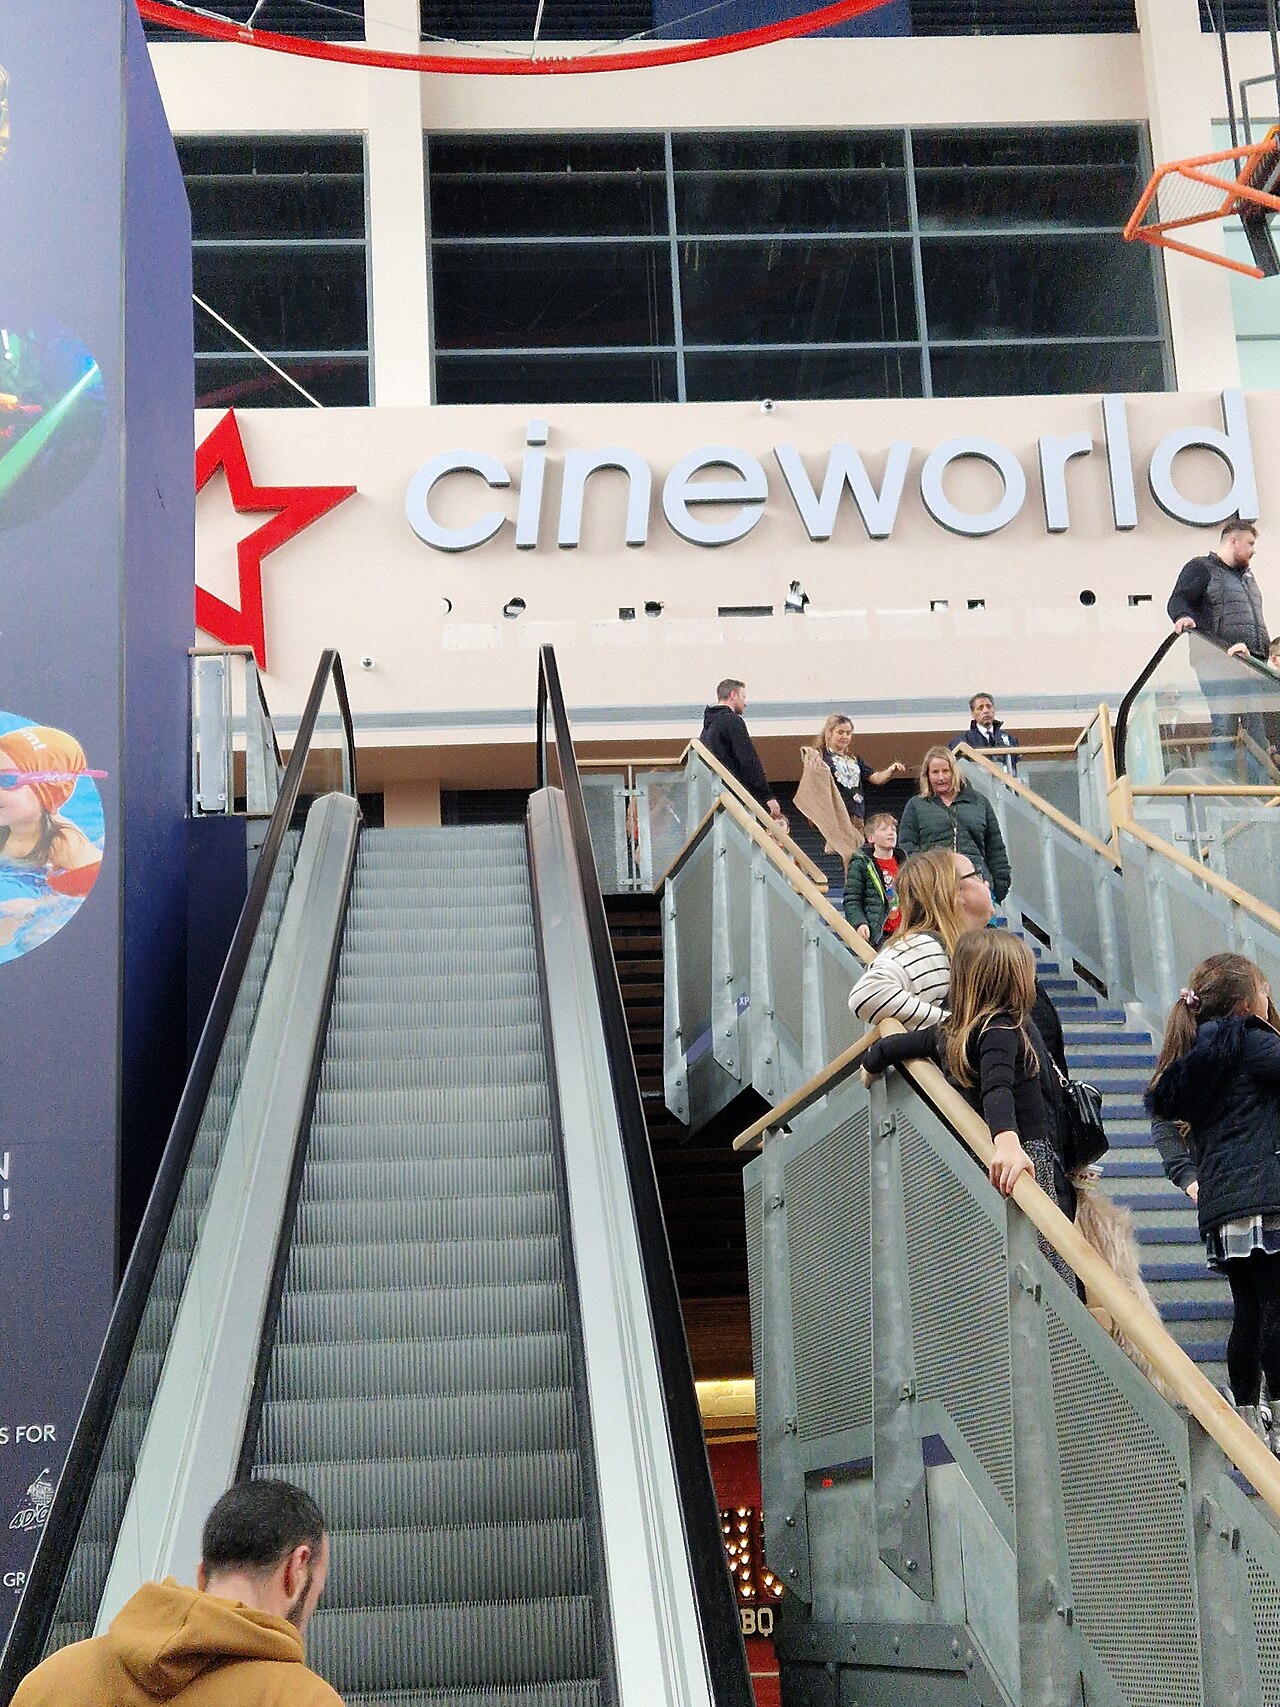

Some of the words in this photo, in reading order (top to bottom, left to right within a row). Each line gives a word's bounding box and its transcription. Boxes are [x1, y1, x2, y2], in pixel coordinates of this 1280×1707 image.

[404, 389, 1260, 552] cineworld
[15, 1424, 57, 1444] FOR
[740, 1607, 774, 1637] BQ
